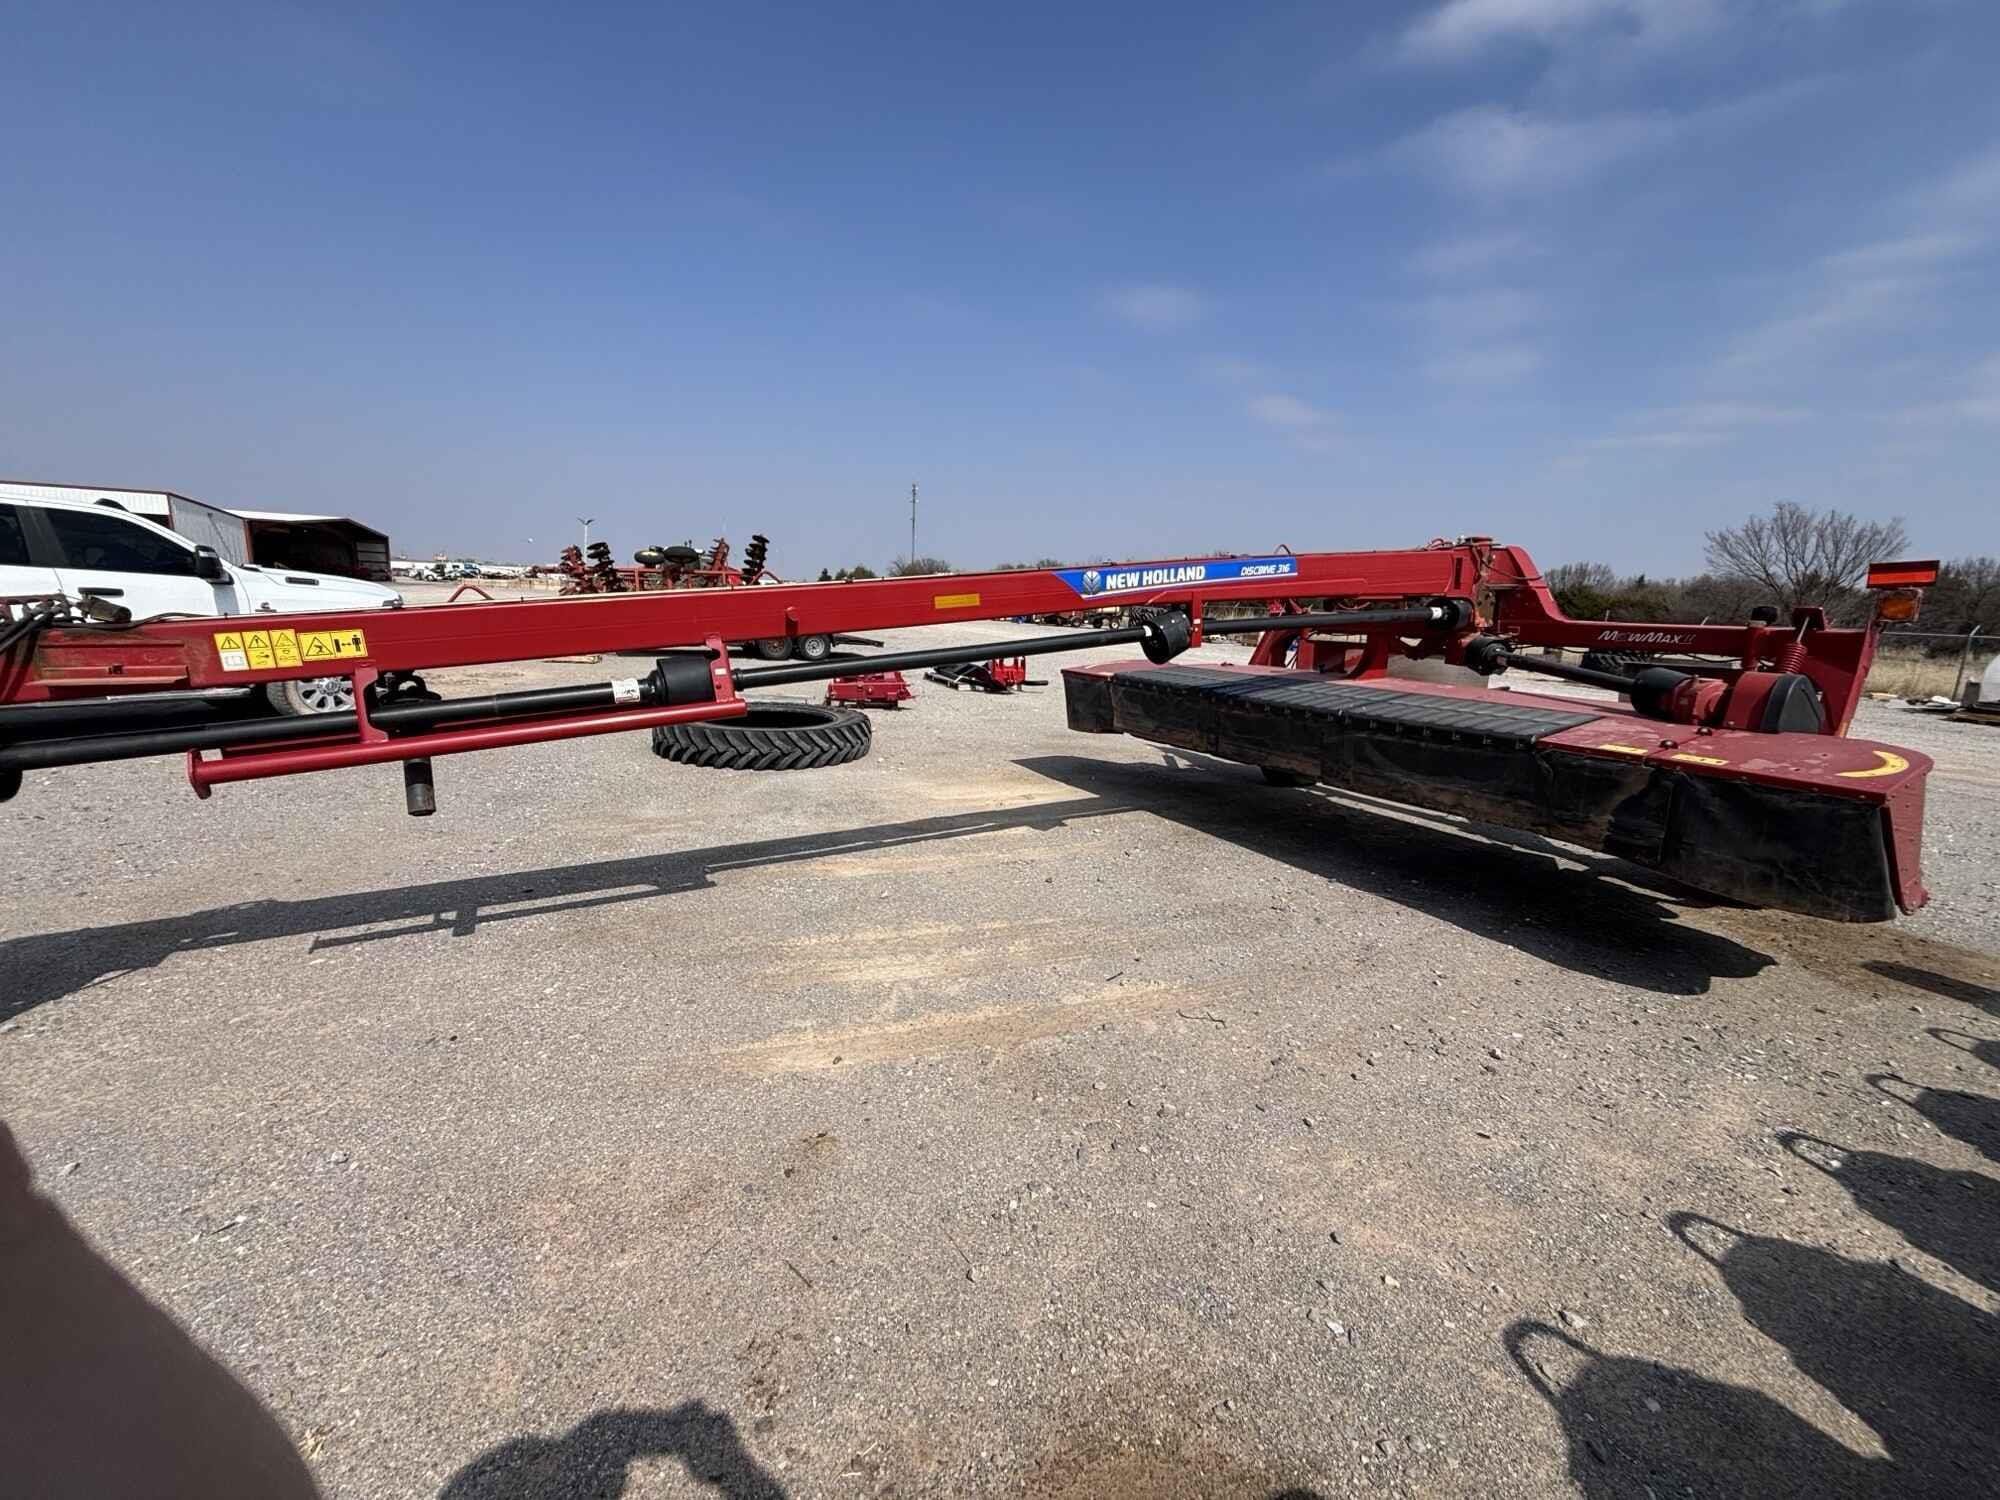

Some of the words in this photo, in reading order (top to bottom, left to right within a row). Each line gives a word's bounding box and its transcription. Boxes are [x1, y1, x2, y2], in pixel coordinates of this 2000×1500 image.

[1277, 563, 1291, 573] 316
[1106, 570, 1140, 589] NEW
[1143, 566, 1206, 585] HOLLAND
